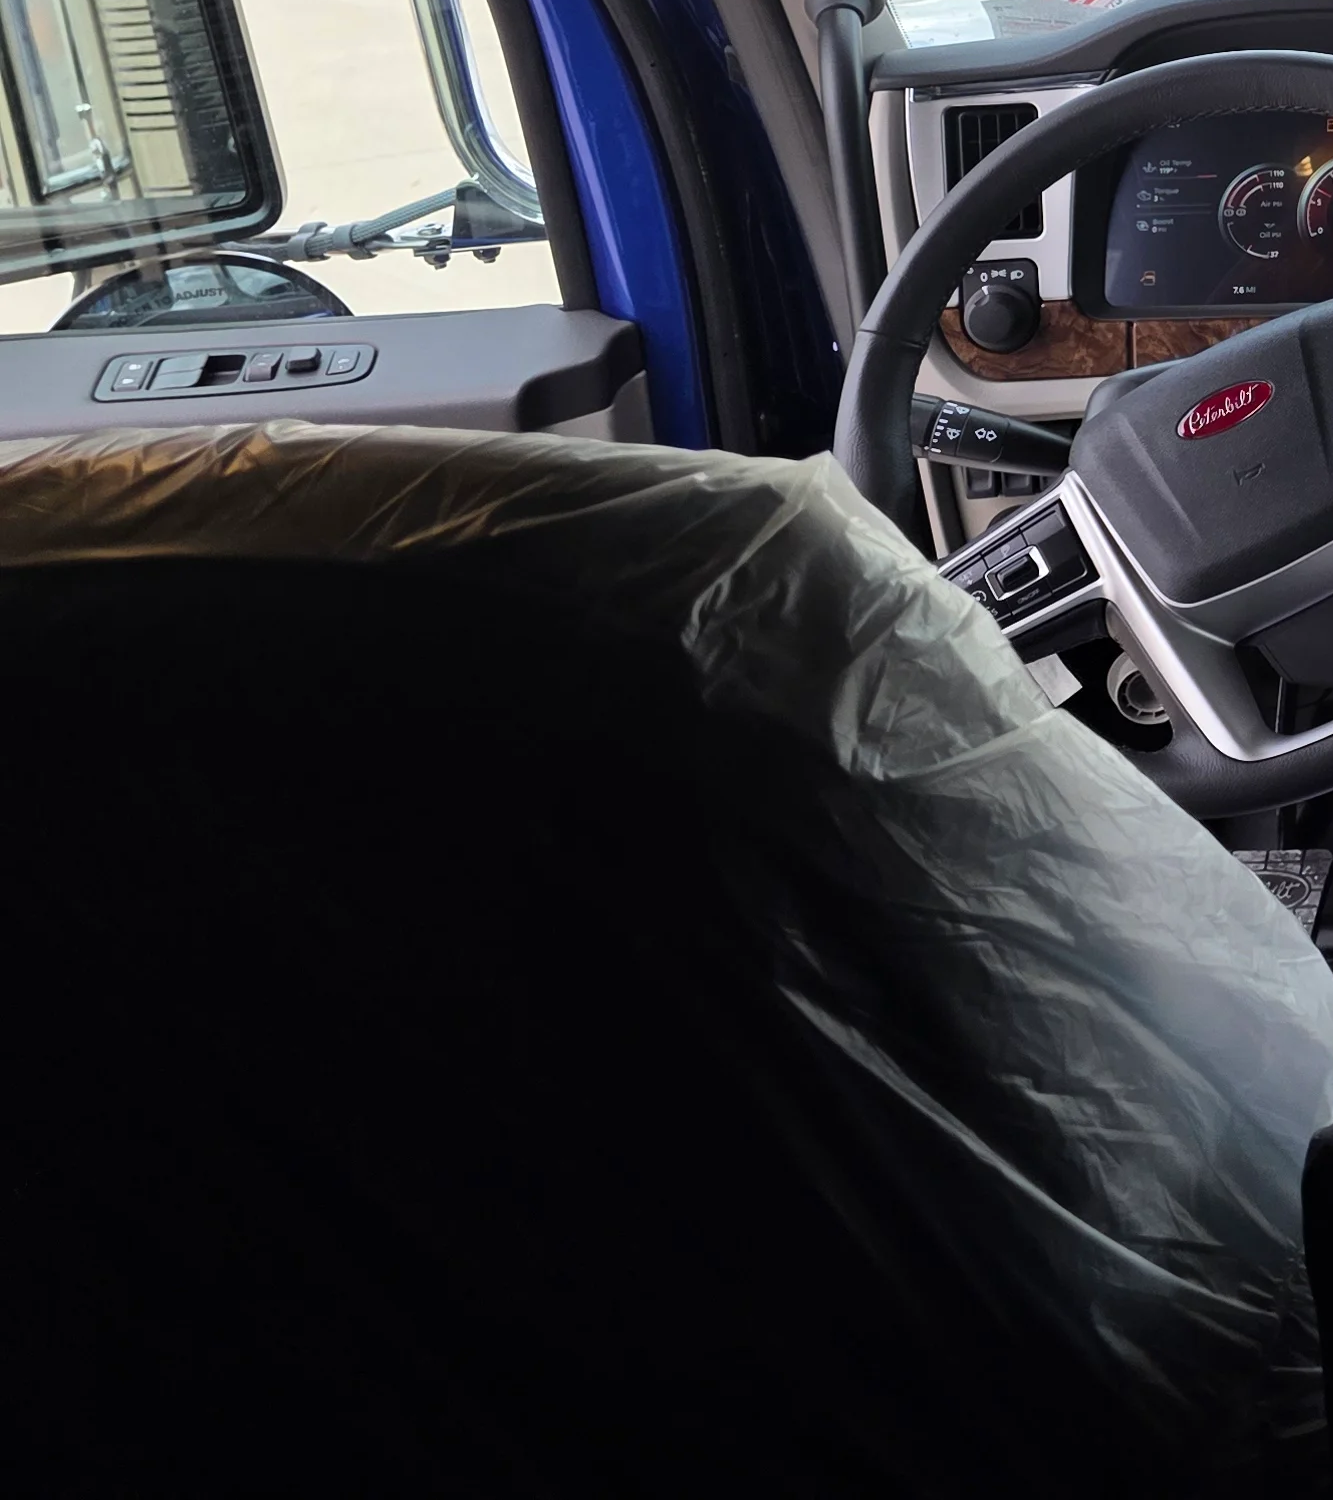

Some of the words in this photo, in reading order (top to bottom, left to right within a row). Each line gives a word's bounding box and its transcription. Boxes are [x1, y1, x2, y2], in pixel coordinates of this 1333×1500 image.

[1259, 231, 1271, 239] Oil
[1317, 227, 1324, 235] 0
[1233, 286, 1245, 294] 7.6
[1246, 286, 1256, 294] MI
[175, 287, 226, 303] ADJUST
[1188, 383, 1259, 435] Peterbilt
